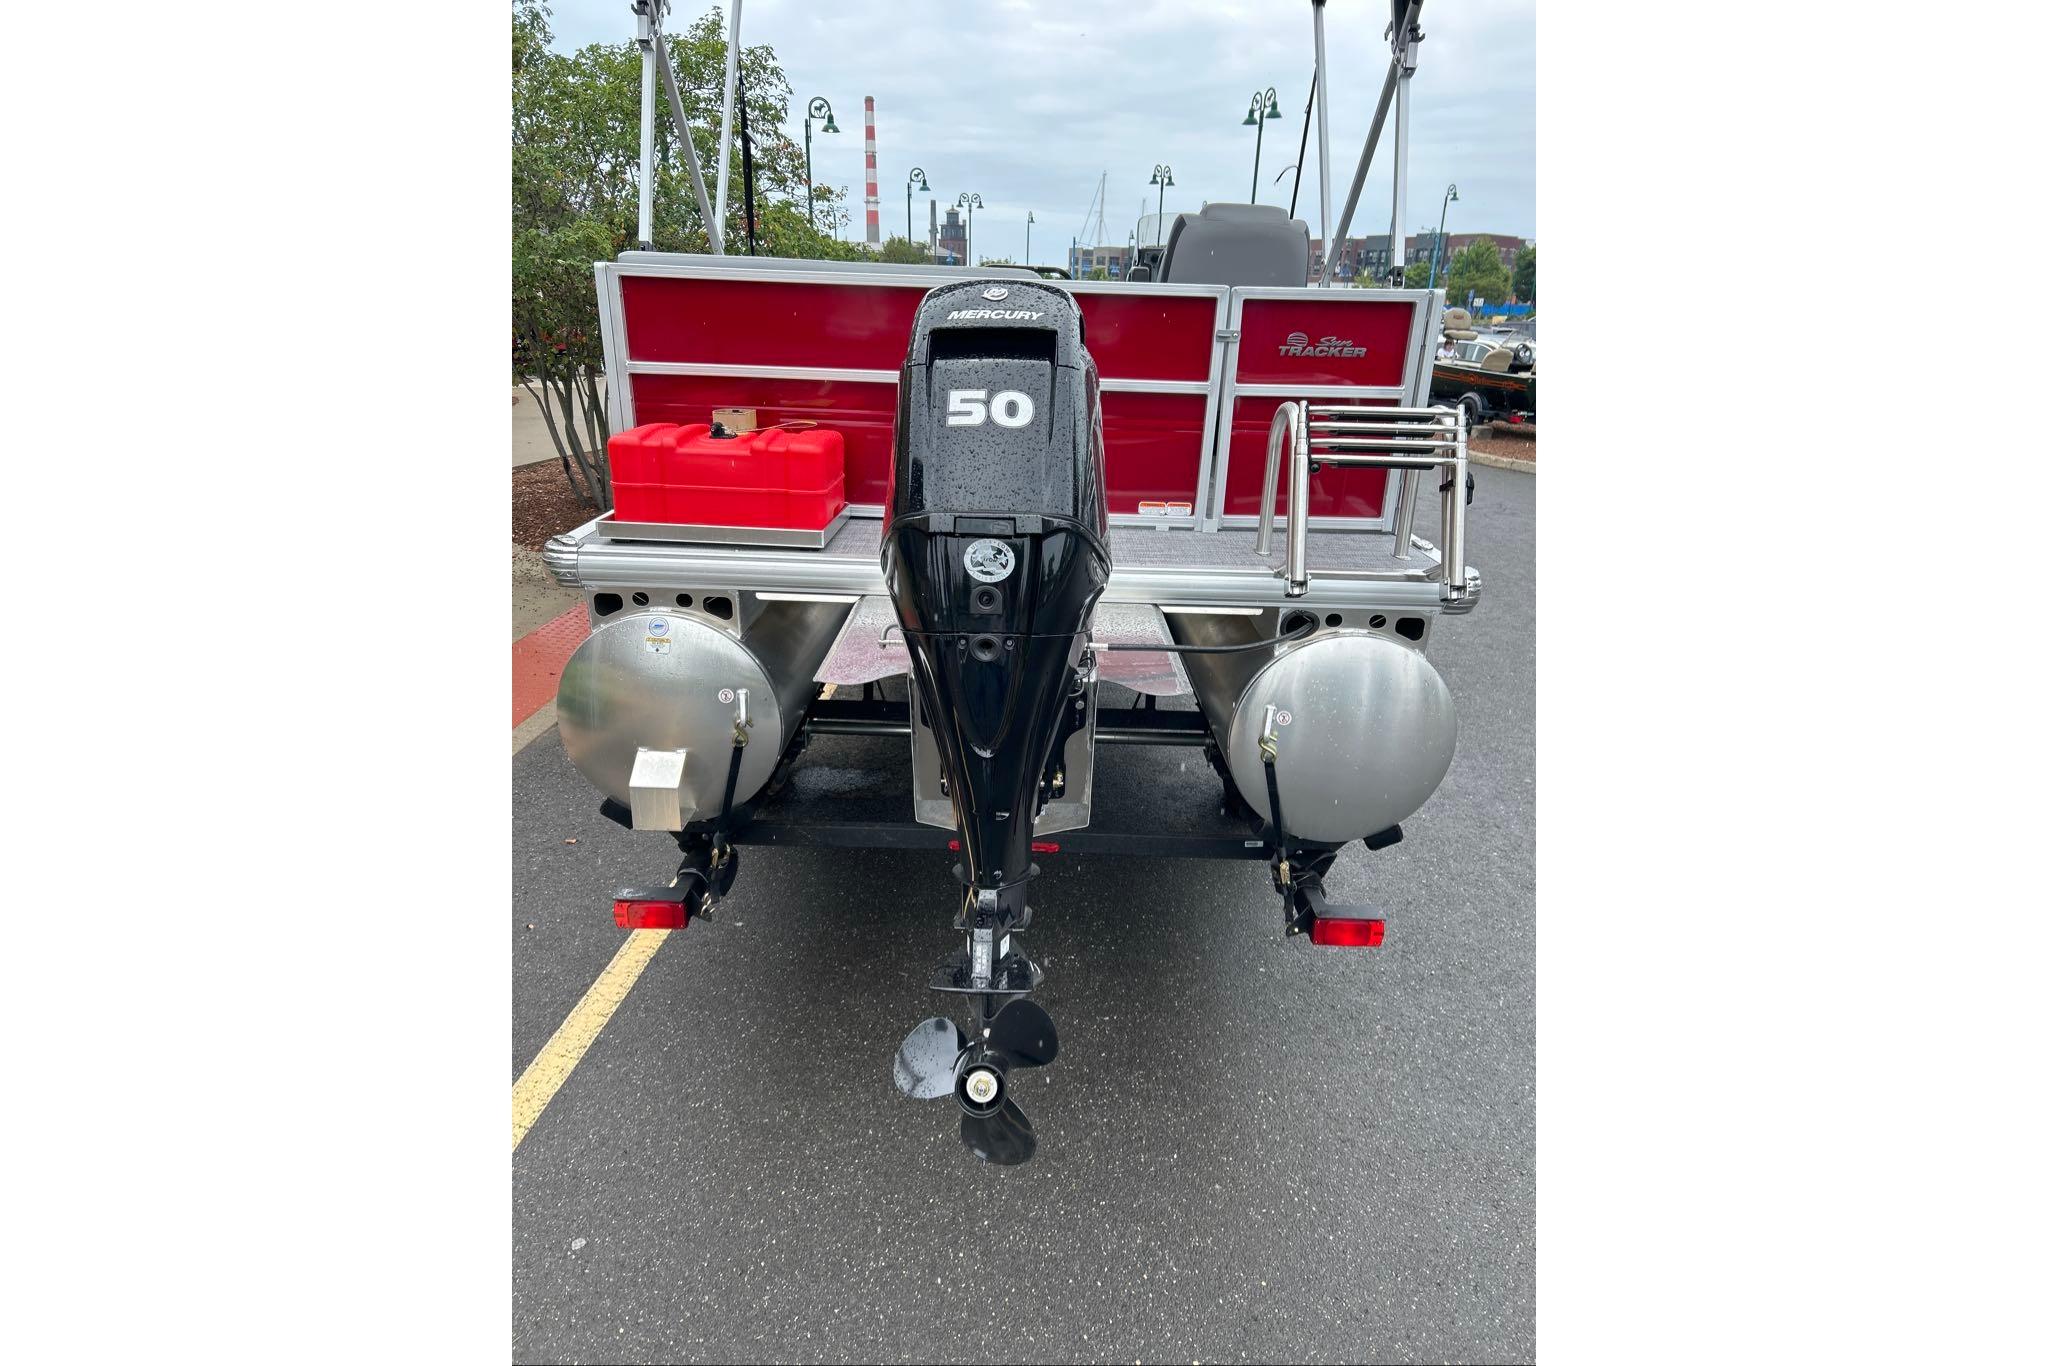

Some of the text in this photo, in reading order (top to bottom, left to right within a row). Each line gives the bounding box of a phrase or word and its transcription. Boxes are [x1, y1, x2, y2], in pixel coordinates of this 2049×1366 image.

[947, 309, 1045, 321] MERCURY
[1315, 336, 1354, 347] Sun
[1278, 345, 1367, 358] TRACKER
[945, 388, 1036, 429] 50
